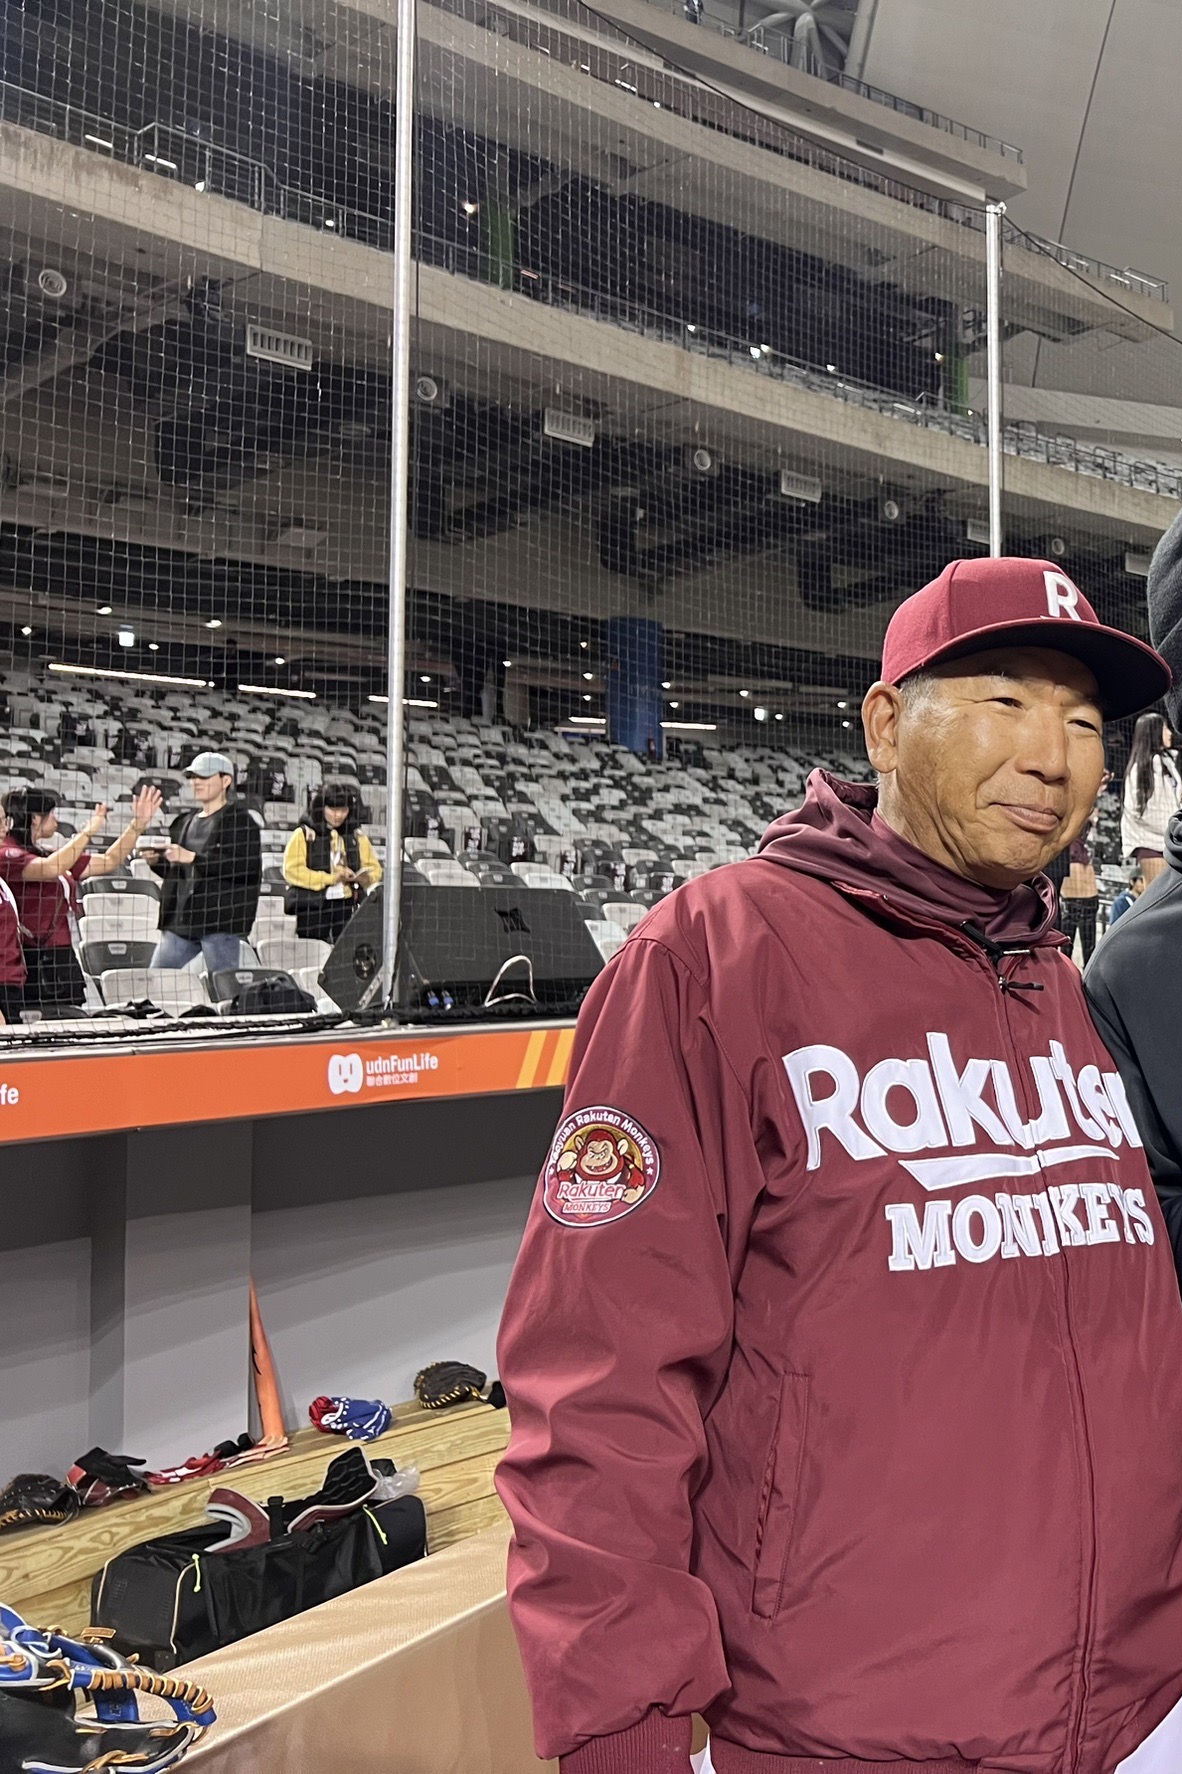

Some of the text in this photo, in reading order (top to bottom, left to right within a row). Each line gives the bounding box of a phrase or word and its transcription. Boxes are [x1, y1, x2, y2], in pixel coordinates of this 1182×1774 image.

[1041, 570, 1081, 621] R
[366, 1052, 439, 1075] udnFunLife
[575, 1111, 621, 1126] Rakuten
[620, 1119, 655, 1165] Monkeys
[557, 1181, 626, 1200] Rakuten
[563, 1202, 612, 1214] MONKEYS
[885, 1182, 1155, 1272] MONKEYS
